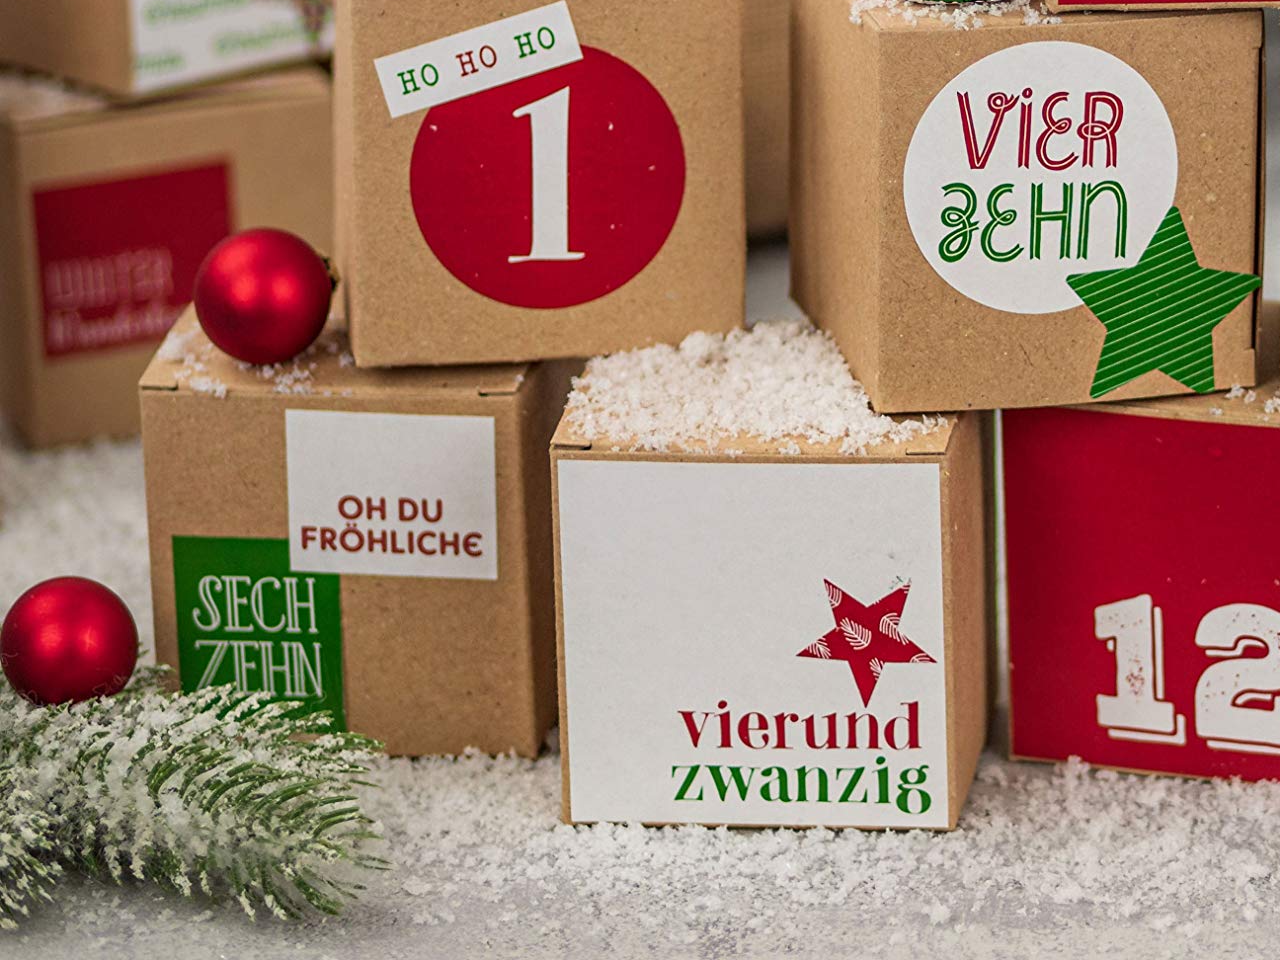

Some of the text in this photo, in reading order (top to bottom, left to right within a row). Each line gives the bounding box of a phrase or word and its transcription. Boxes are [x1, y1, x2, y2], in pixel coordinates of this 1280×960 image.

[397, 26, 555, 95] HO HO HO
[507, 85, 586, 264] 1
[338, 495, 443, 522] OH DU
[301, 523, 483, 557] FRÖHLICHE
[192, 575, 318, 633] SECH
[195, 640, 323, 698] ZEHN
[677, 700, 922, 750] vierund
[672, 756, 932, 814] zwanzig
